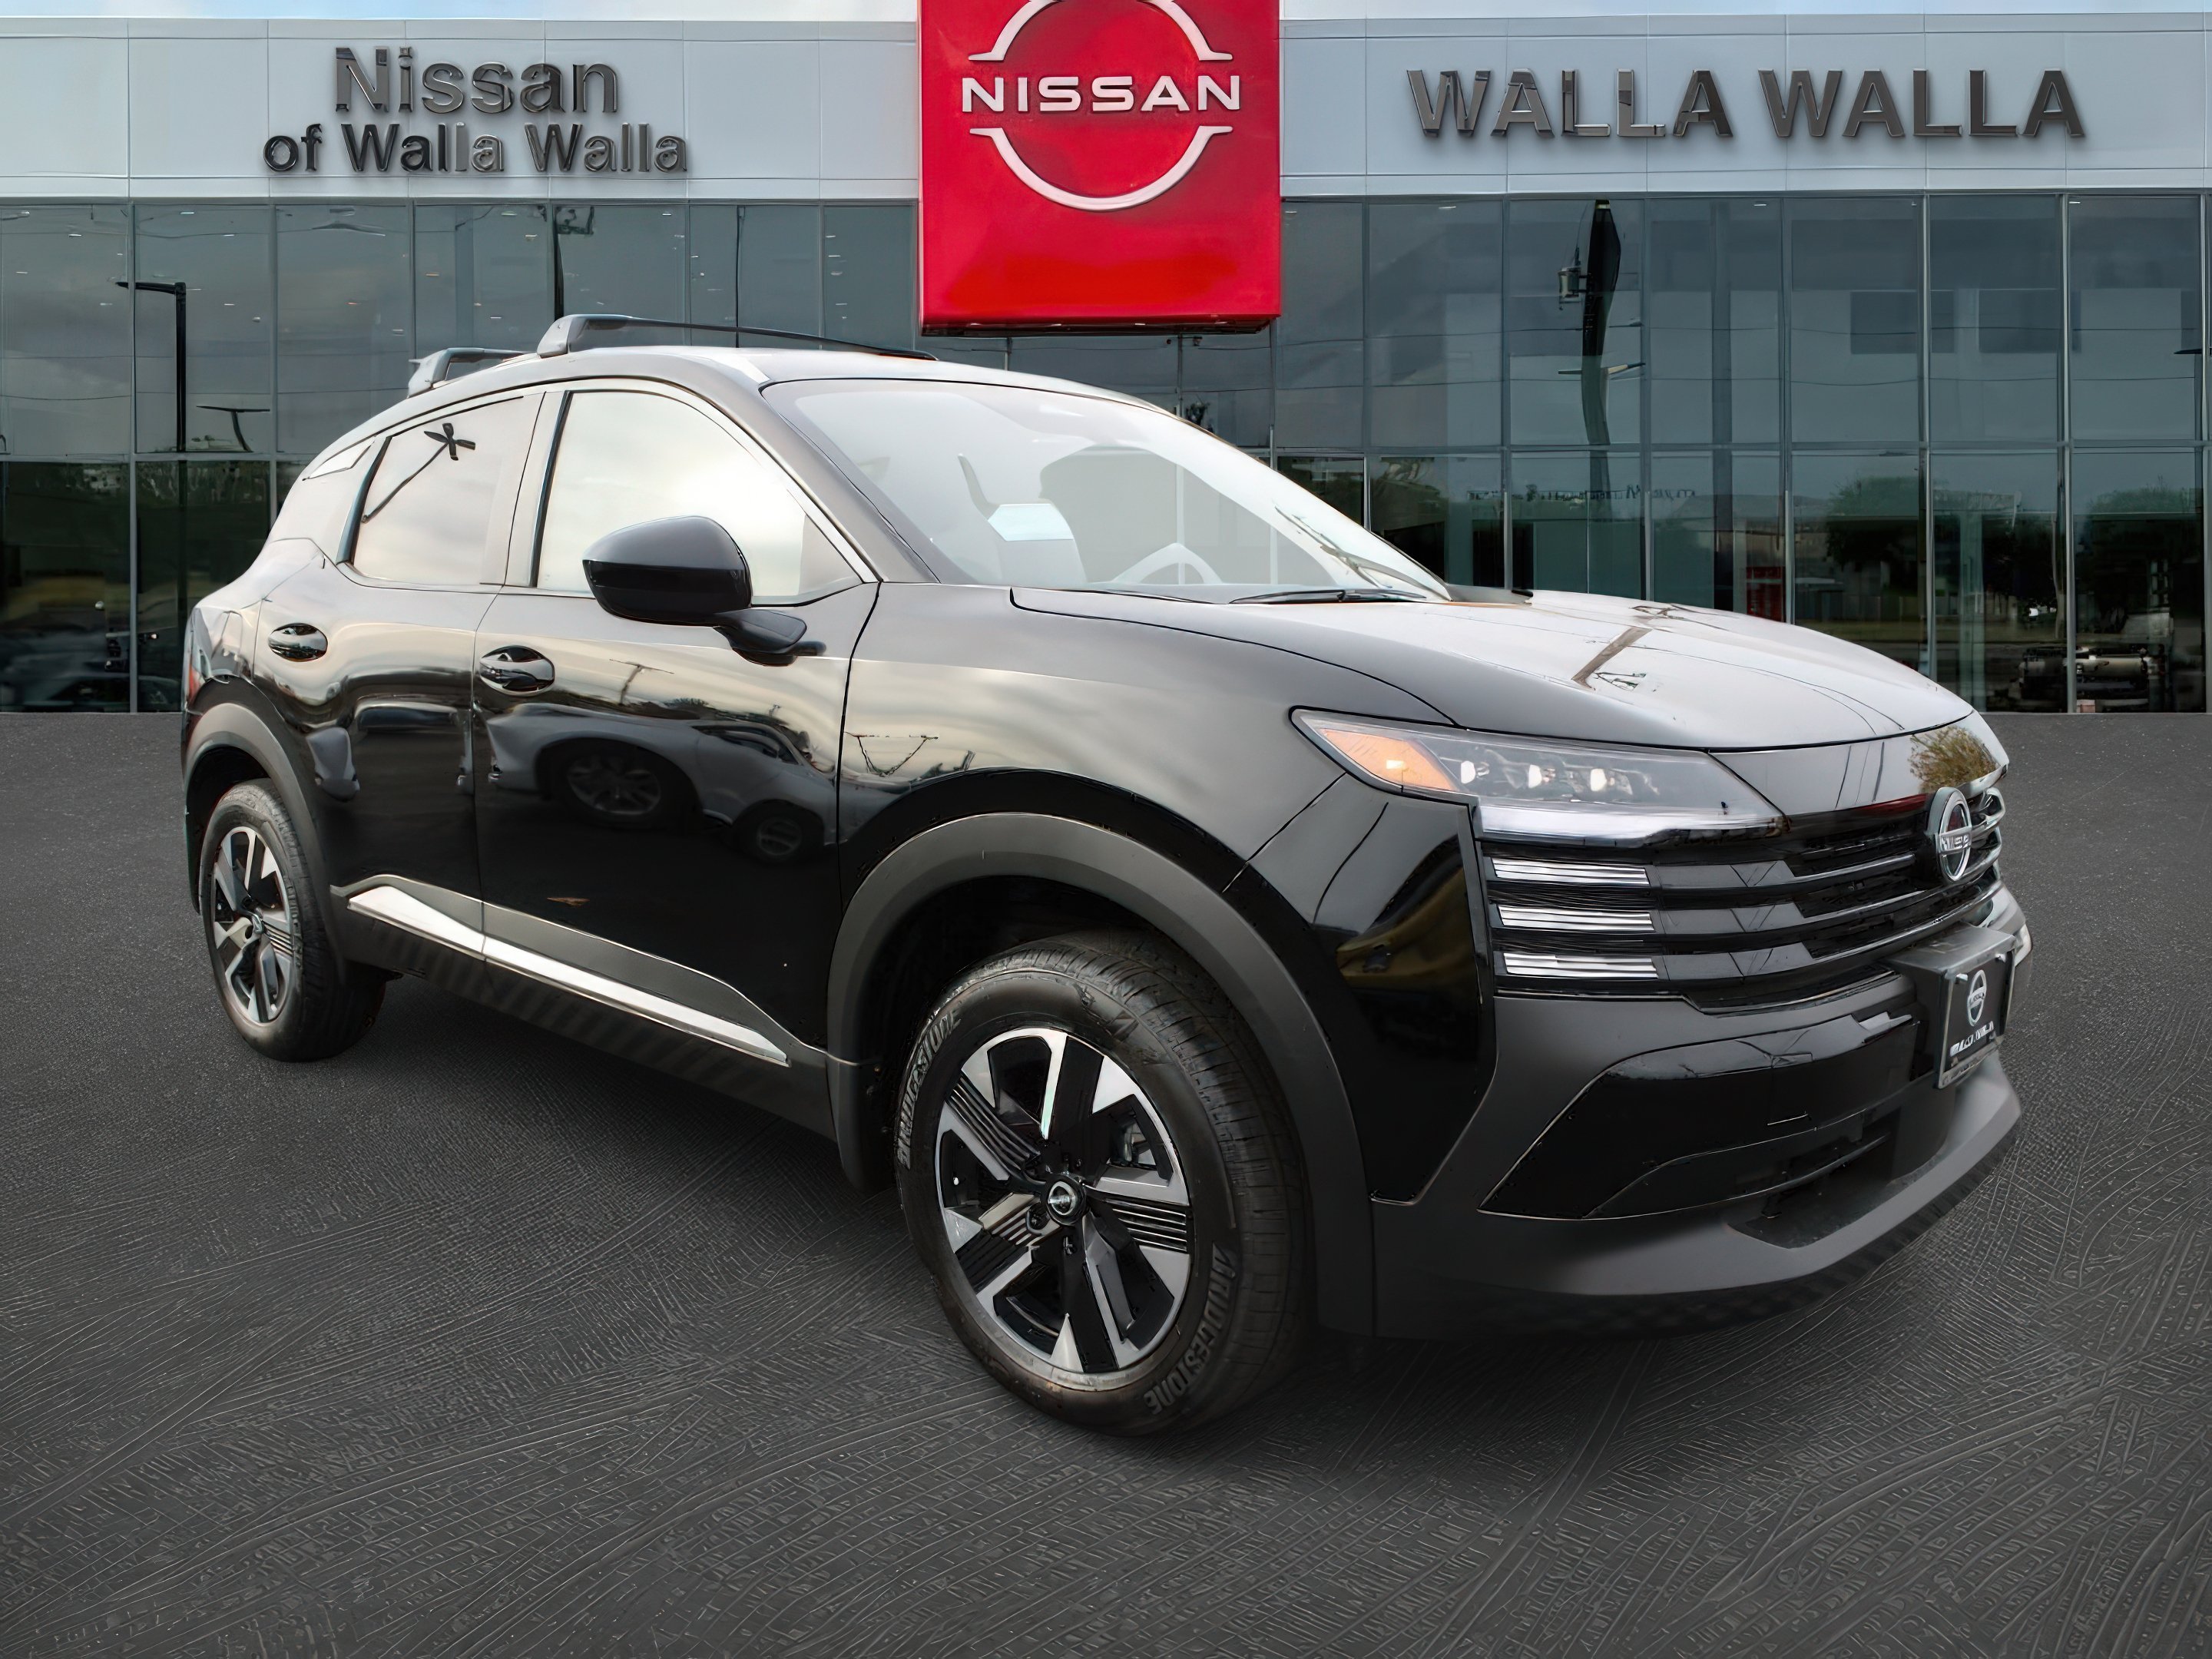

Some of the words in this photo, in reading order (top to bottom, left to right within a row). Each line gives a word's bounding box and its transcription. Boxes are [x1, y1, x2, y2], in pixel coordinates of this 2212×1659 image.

[336, 47, 619, 113] Nissan
[962, 75, 1240, 112] NISSAN
[1407, 68, 1734, 139] WALLA
[1757, 68, 2085, 139] WALLA
[263, 124, 323, 171] of
[341, 122, 504, 171] Walla
[523, 122, 687, 171] Walla
